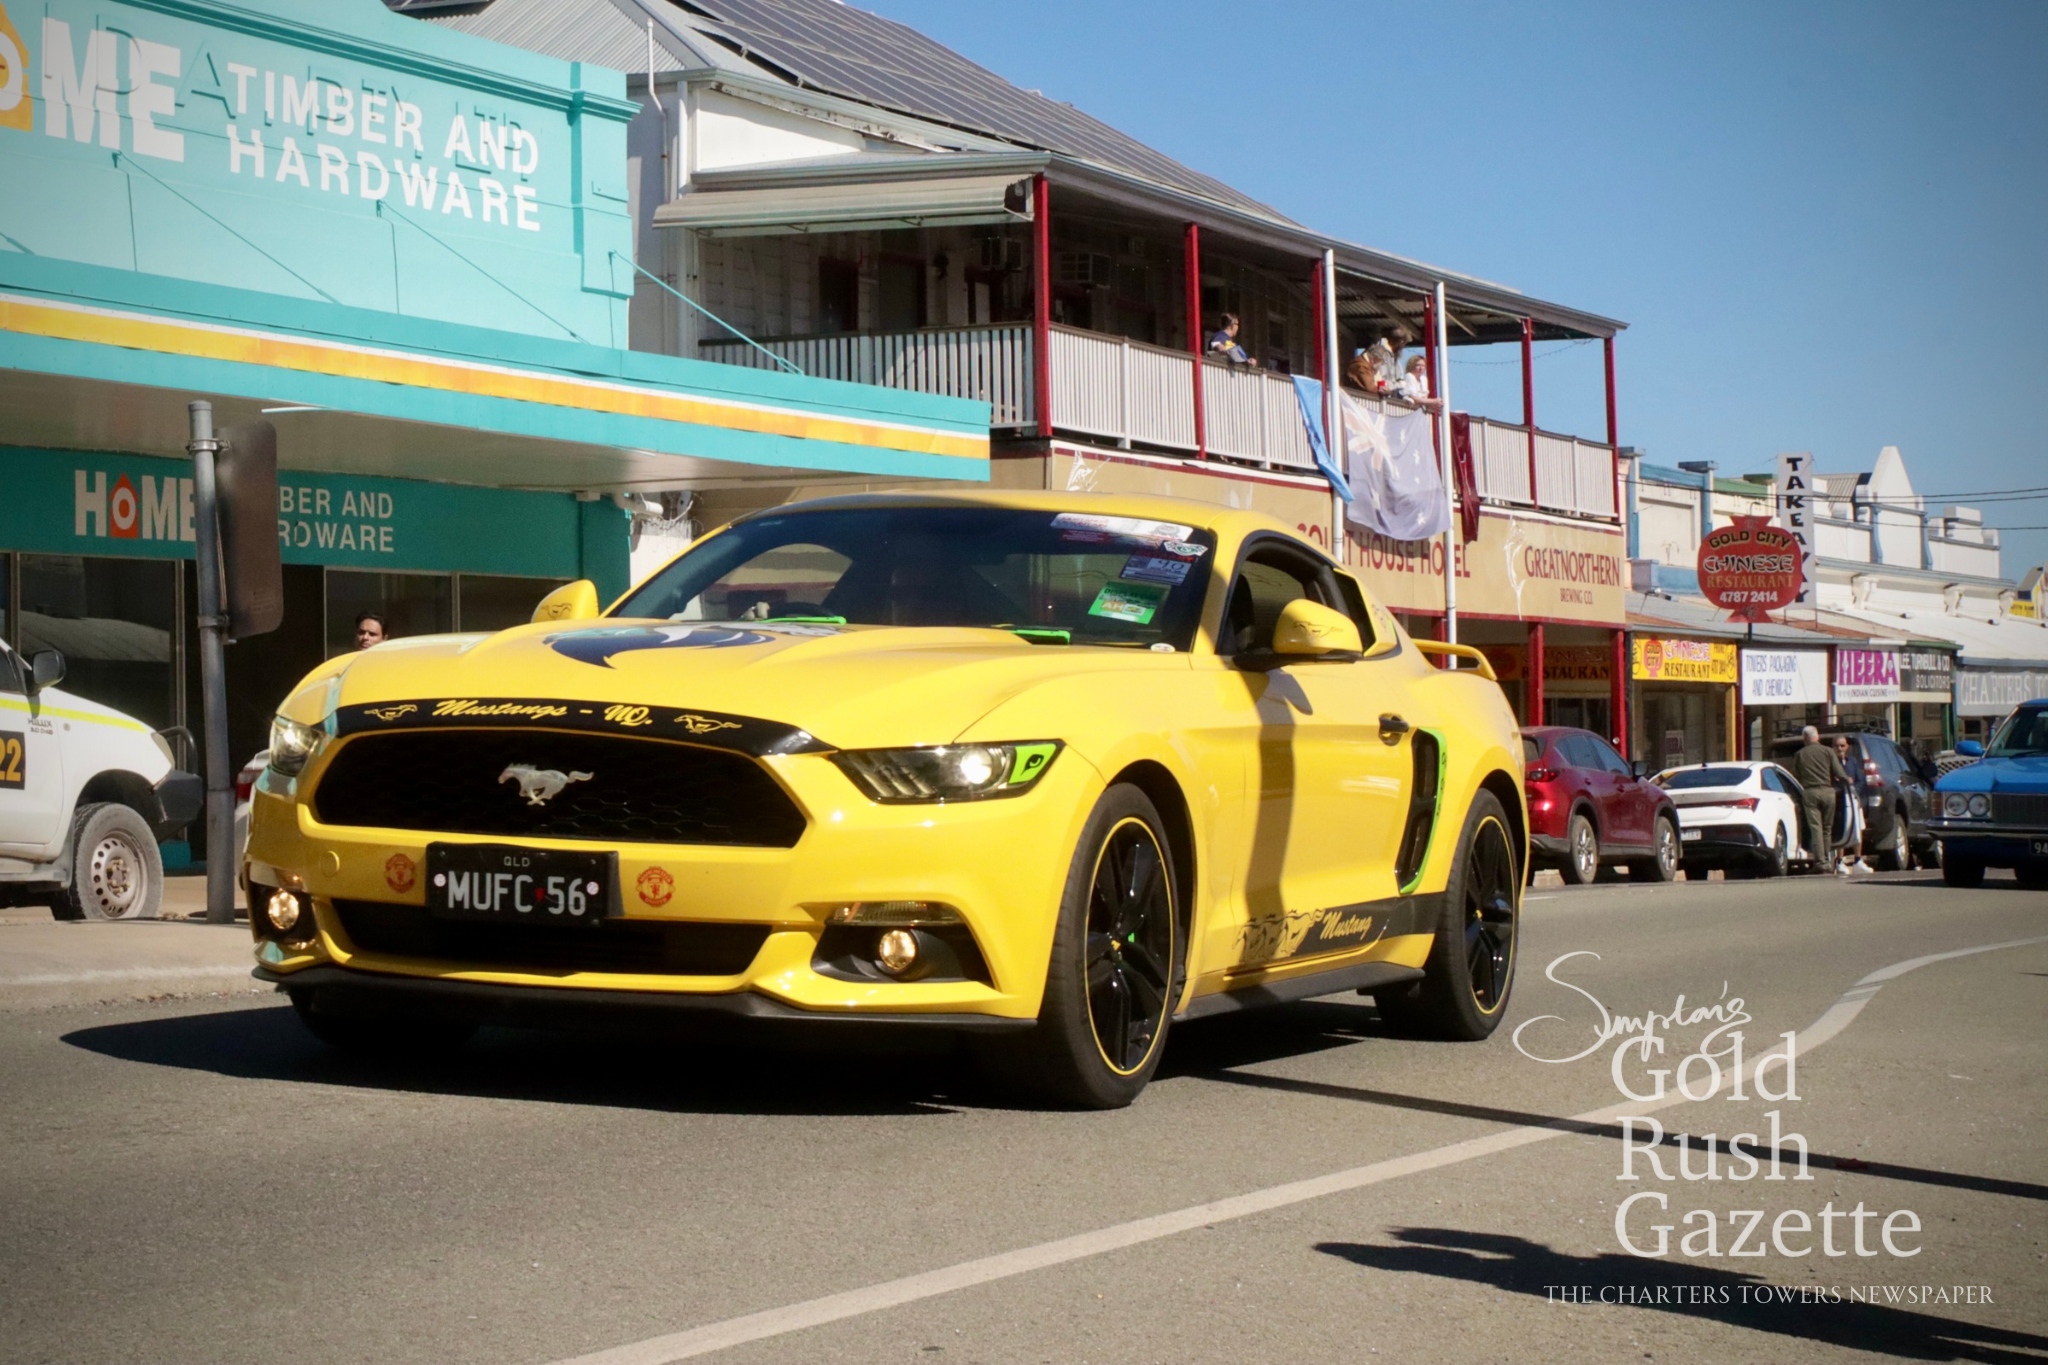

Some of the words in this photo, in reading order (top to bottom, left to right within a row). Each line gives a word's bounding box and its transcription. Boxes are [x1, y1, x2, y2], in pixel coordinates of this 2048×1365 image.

[227, 62, 424, 152] TIMBER
[444, 114, 539, 175] AND
[226, 123, 541, 232] HARDWARE
[279, 485, 331, 516] BER
[341, 490, 393, 520] AND
[277, 519, 394, 553] RDWARE
[1709, 530, 1750, 549] GOLD
[1756, 531, 1791, 548] CITY
[1786, 457, 1811, 603] TAKEAY
[1359, 530, 1415, 573] HOUSE
[1420, 540, 1471, 578] HOEL
[1703, 554, 1794, 573] CHINESE
[1706, 574, 1794, 588] RESTAURANT
[1720, 591, 1748, 602] 4787
[1750, 591, 1778, 602] 2414
[1664, 639, 1711, 662] CHINESE
[1522, 665, 1609, 679] RSTAURAN
[1664, 662, 1710, 678] RESTAURANT
[1838, 649, 1899, 685] HEERA
[1752, 678, 1763, 696] AND
[1915, 674, 1950, 689] SOLICITORS
[1960, 673, 2031, 706] CHARTERS
[432, 699, 567, 720] Mustangs
[503, 856, 530, 867] QLD
[448, 870, 533, 913] MUFC
[547, 876, 586, 916] 56
[1319, 910, 1372, 940] Mustang
